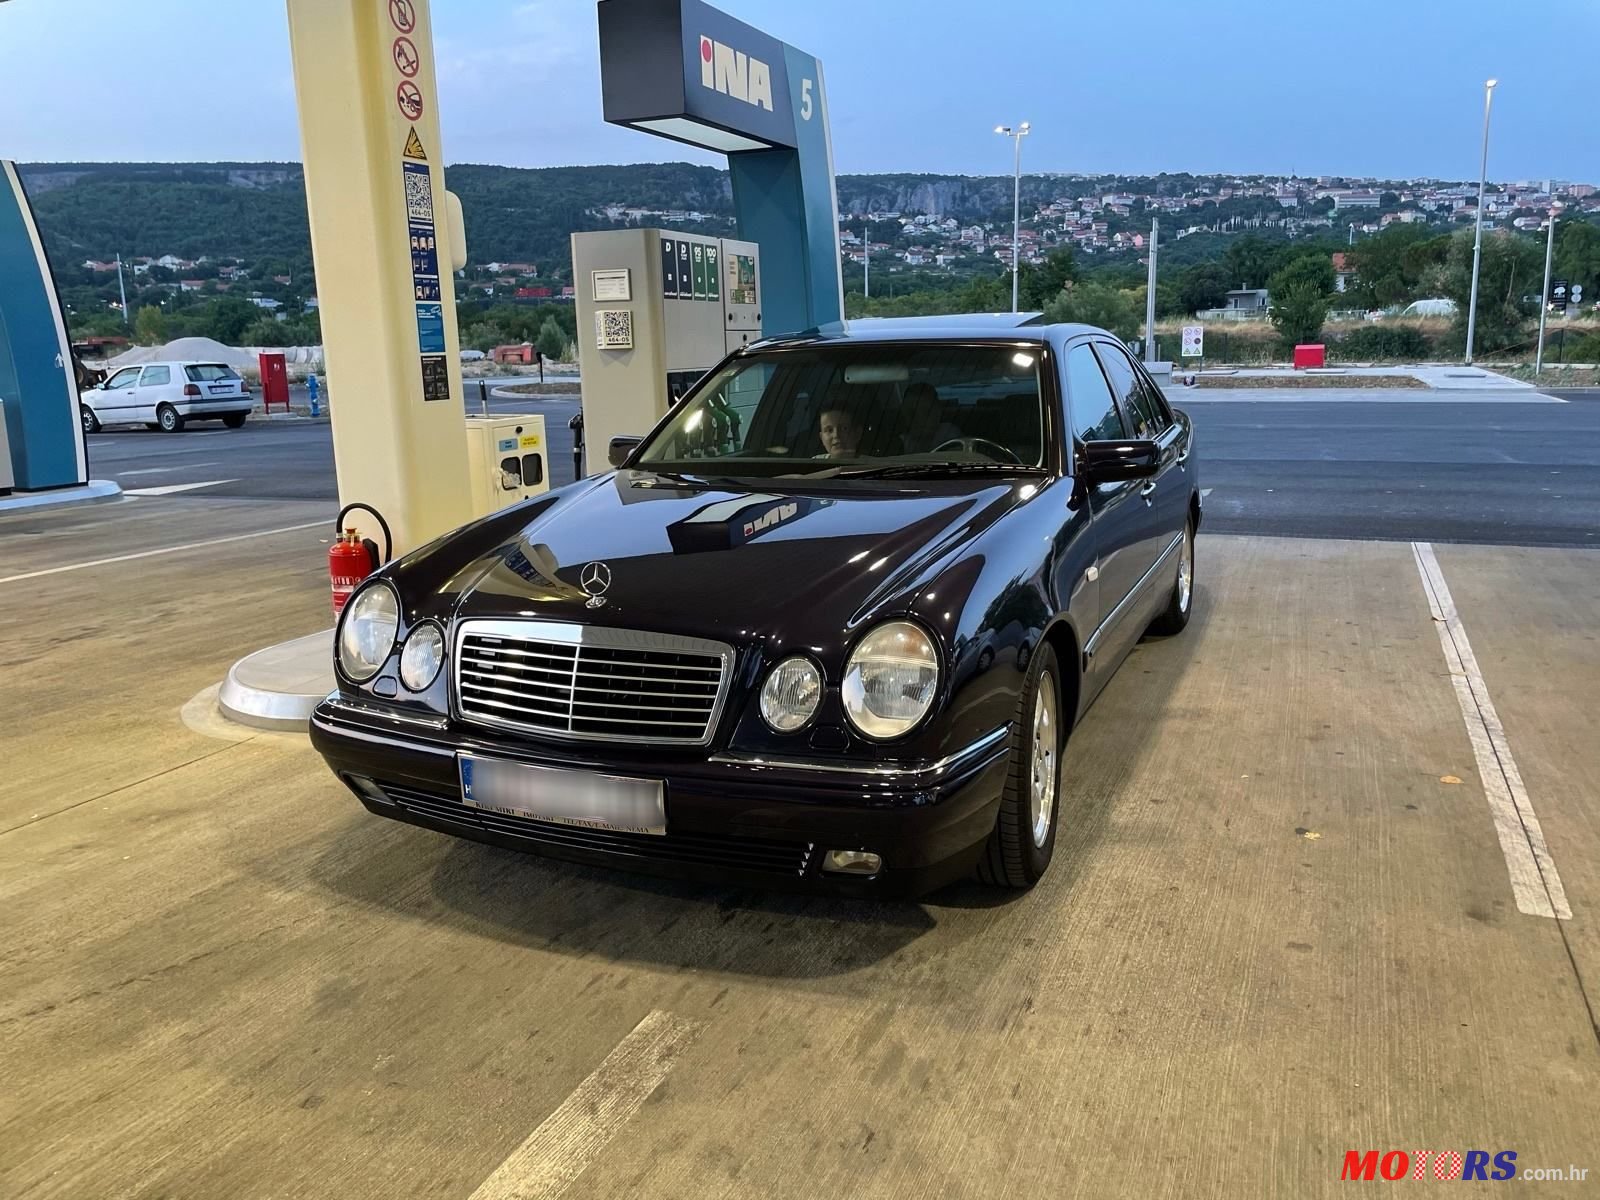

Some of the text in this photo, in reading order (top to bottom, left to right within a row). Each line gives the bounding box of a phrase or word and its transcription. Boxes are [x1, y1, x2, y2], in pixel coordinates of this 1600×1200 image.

[700, 34, 774, 112] INA
[800, 79, 813, 121] 5
[665, 242, 672, 252] D
[681, 244, 687, 254] D
[694, 246, 702, 257] 95
[706, 247, 717, 258] 100
